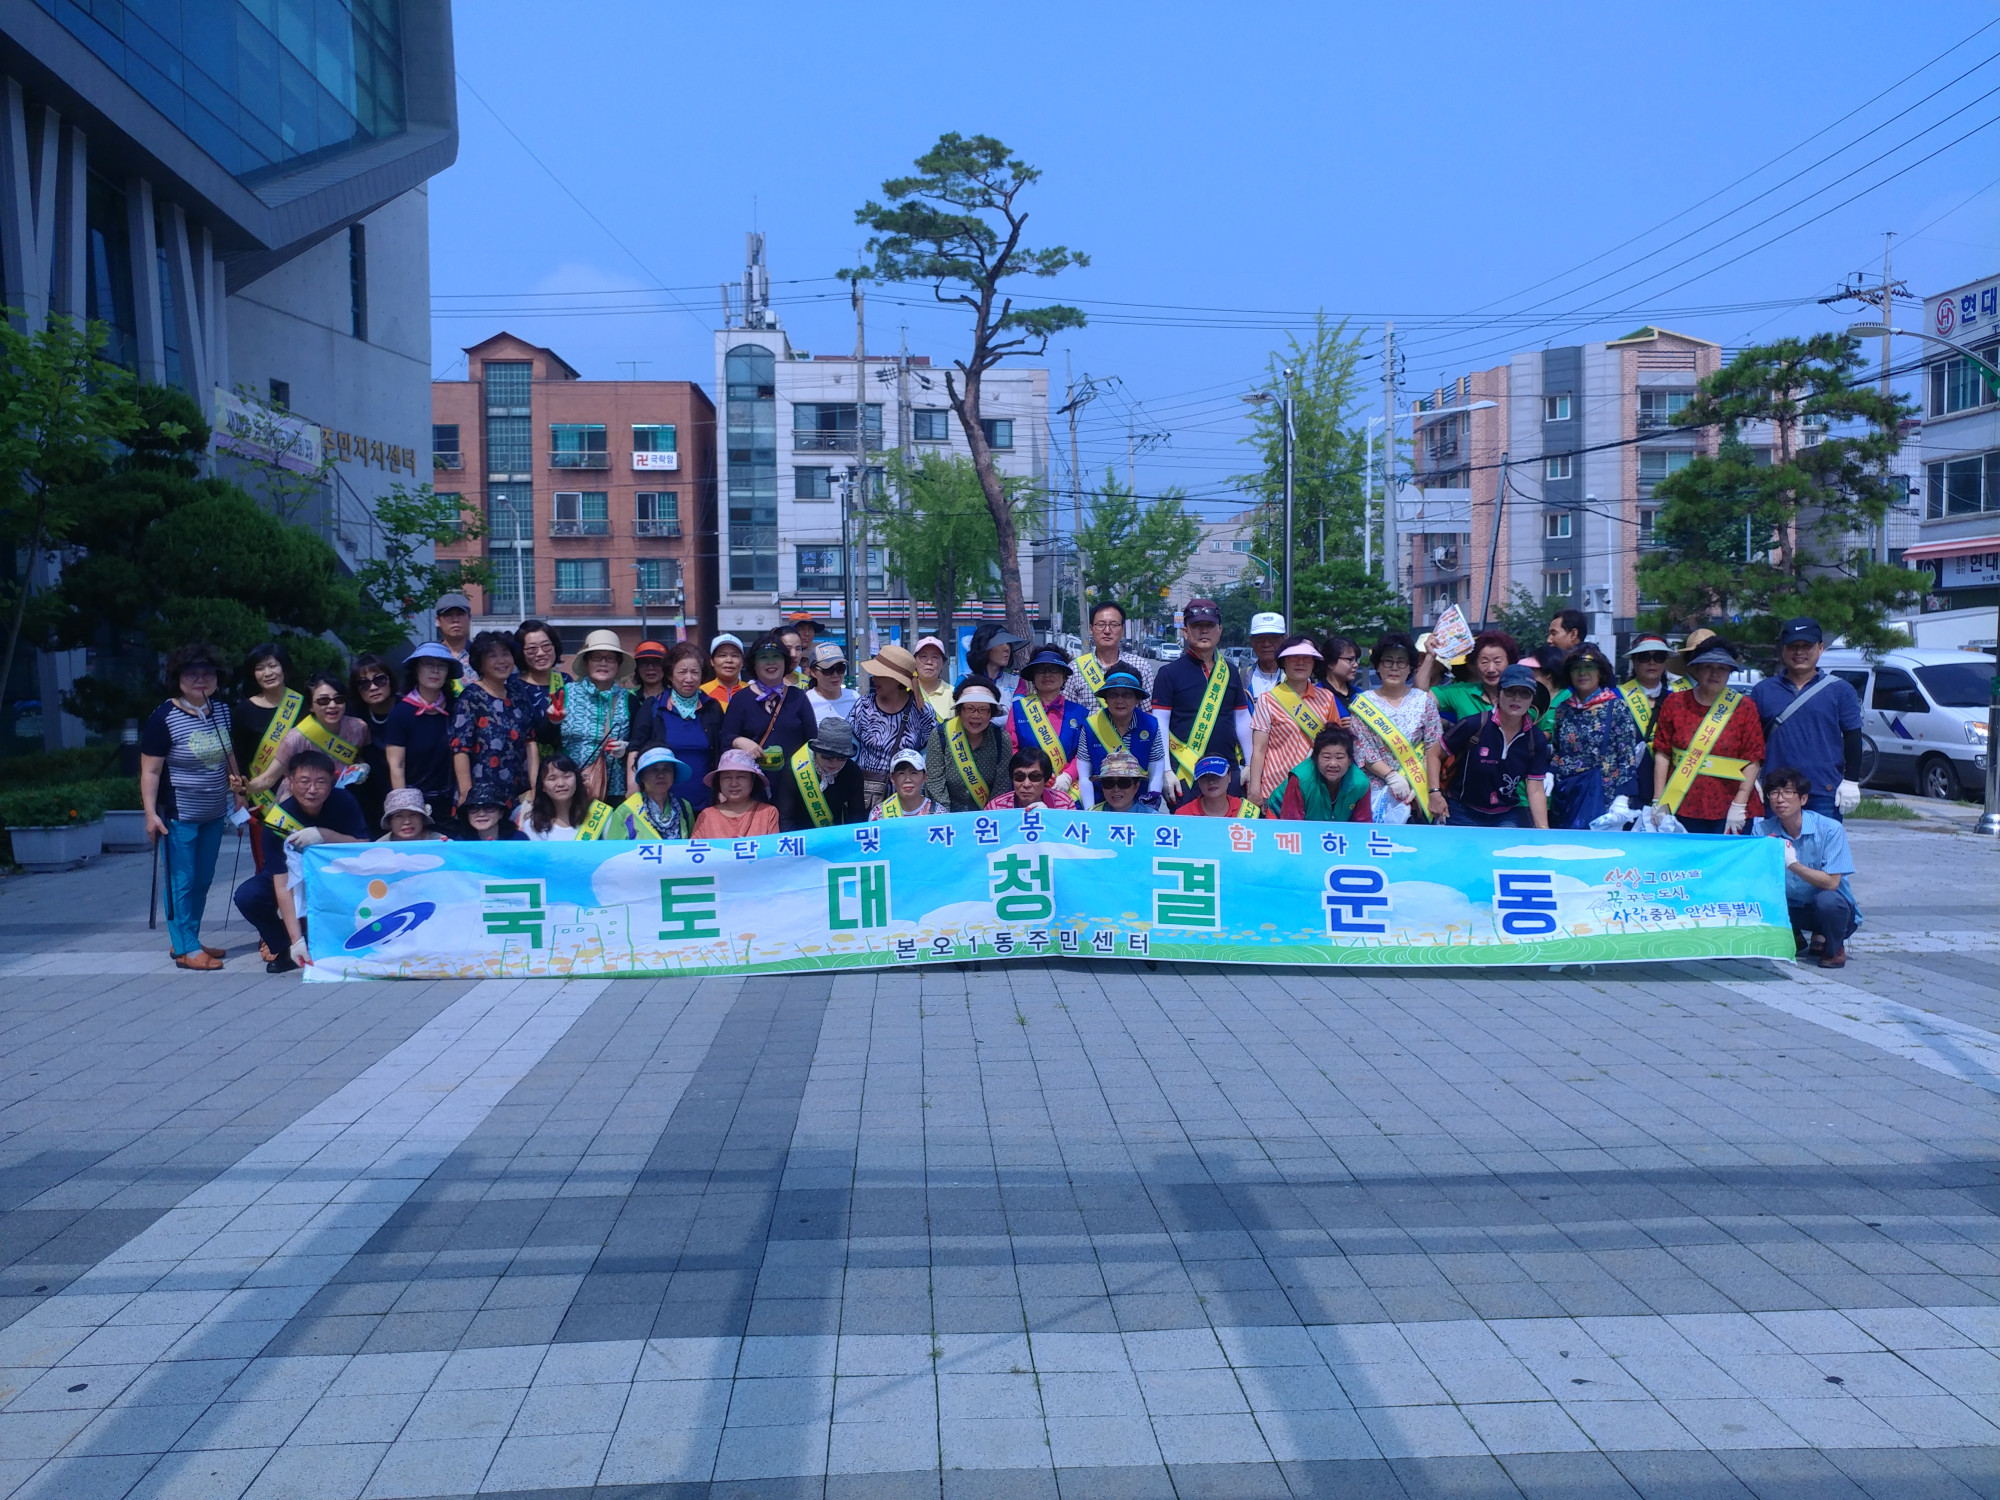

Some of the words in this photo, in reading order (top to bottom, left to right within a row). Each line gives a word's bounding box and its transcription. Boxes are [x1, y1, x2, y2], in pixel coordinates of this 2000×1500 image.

[1961, 287, 1997, 324] 현대
[322, 427, 416, 477] 주민자치센터
[651, 454, 674, 465] 극락암
[282, 700, 296, 720] 내집
[1300, 711, 1319, 730] 내집
[1029, 704, 1042, 723] 내집
[1050, 747, 1064, 766] 내가
[1356, 701, 1376, 716] 내집
[1392, 736, 1409, 754] 내가
[1405, 757, 1426, 784] 깨끗이
[1698, 725, 1716, 746] 내가
[258, 744, 274, 765] 내가
[955, 741, 968, 762] 내집
[1681, 748, 1704, 778] 깨끗이
[640, 836, 805, 864] 직능단체
[856, 827, 879, 852] 및
[929, 811, 1182, 847] 자원봉사자와
[1230, 824, 1393, 857] 함께하는
[1644, 872, 1657, 884] 그
[1685, 902, 1763, 919] 안산특별시
